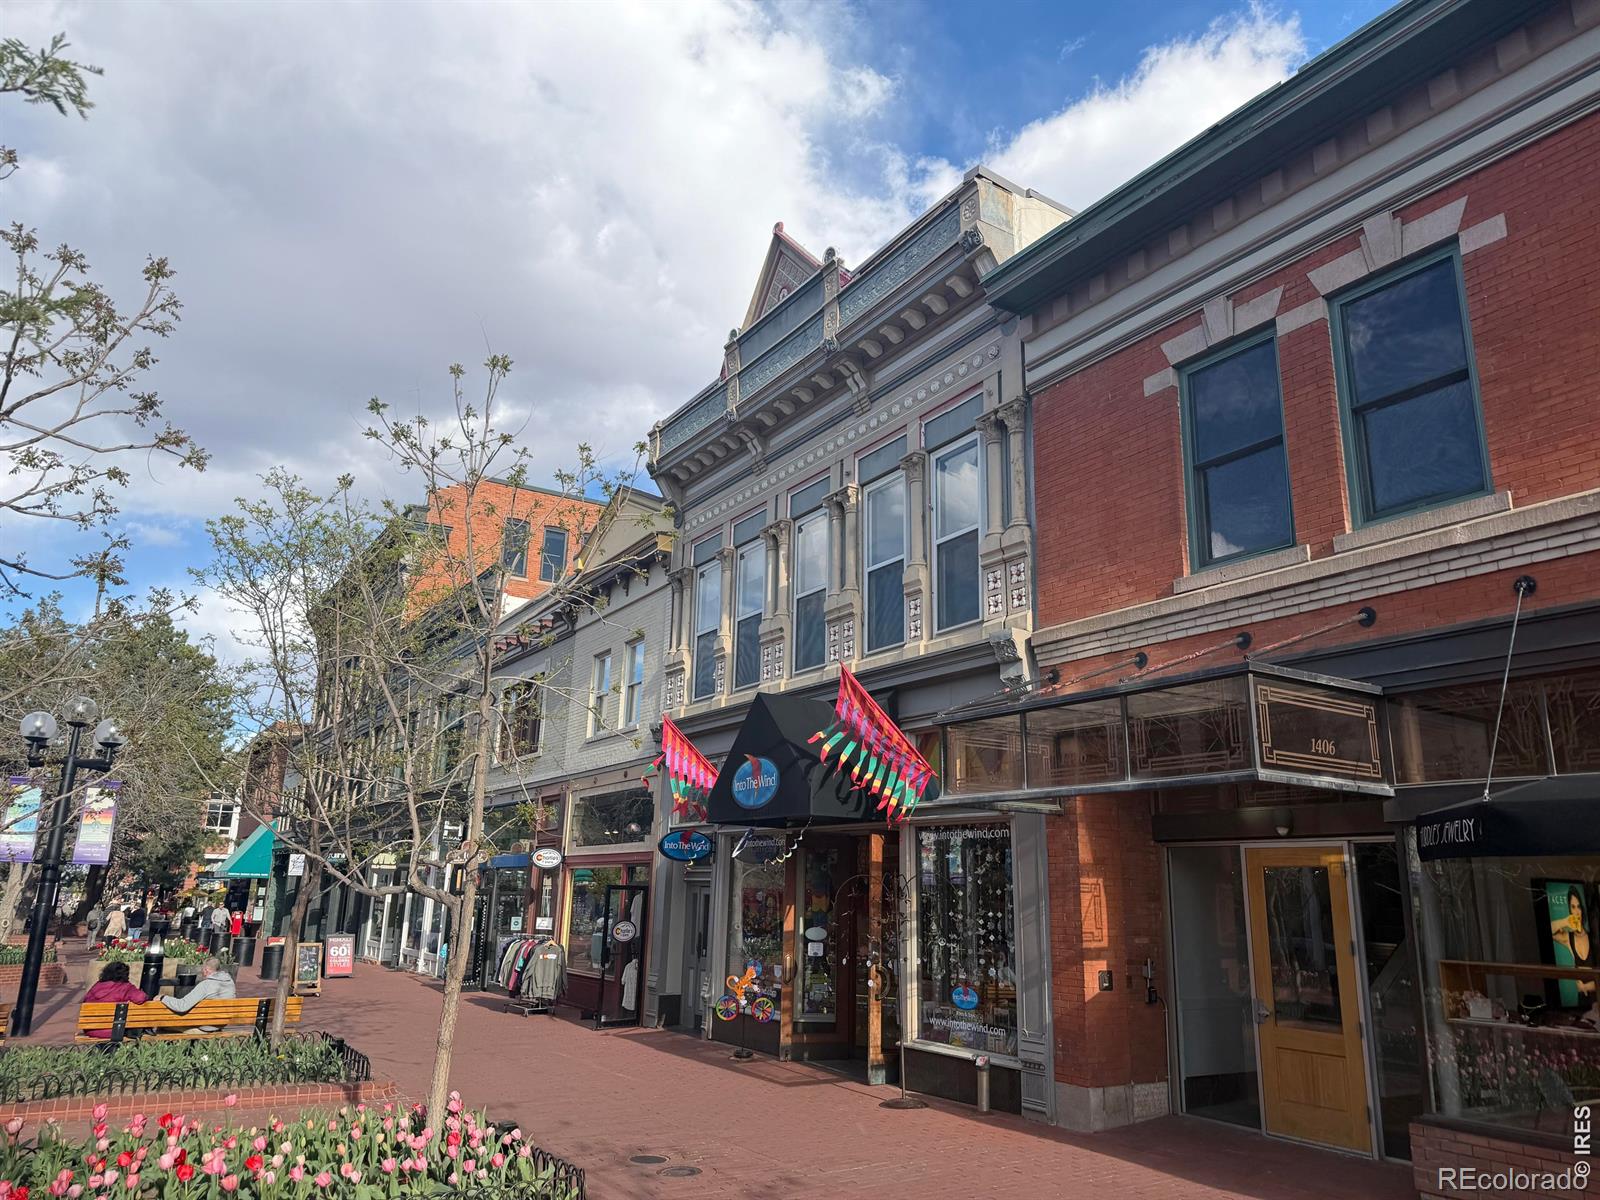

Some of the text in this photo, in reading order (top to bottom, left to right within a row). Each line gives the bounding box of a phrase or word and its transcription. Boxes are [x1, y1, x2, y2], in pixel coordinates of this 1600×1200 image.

[1310, 738, 1336, 756] 1406
[734, 773, 776, 792] Into The Wind
[664, 840, 679, 850] Into
[678, 840, 691, 850] The
